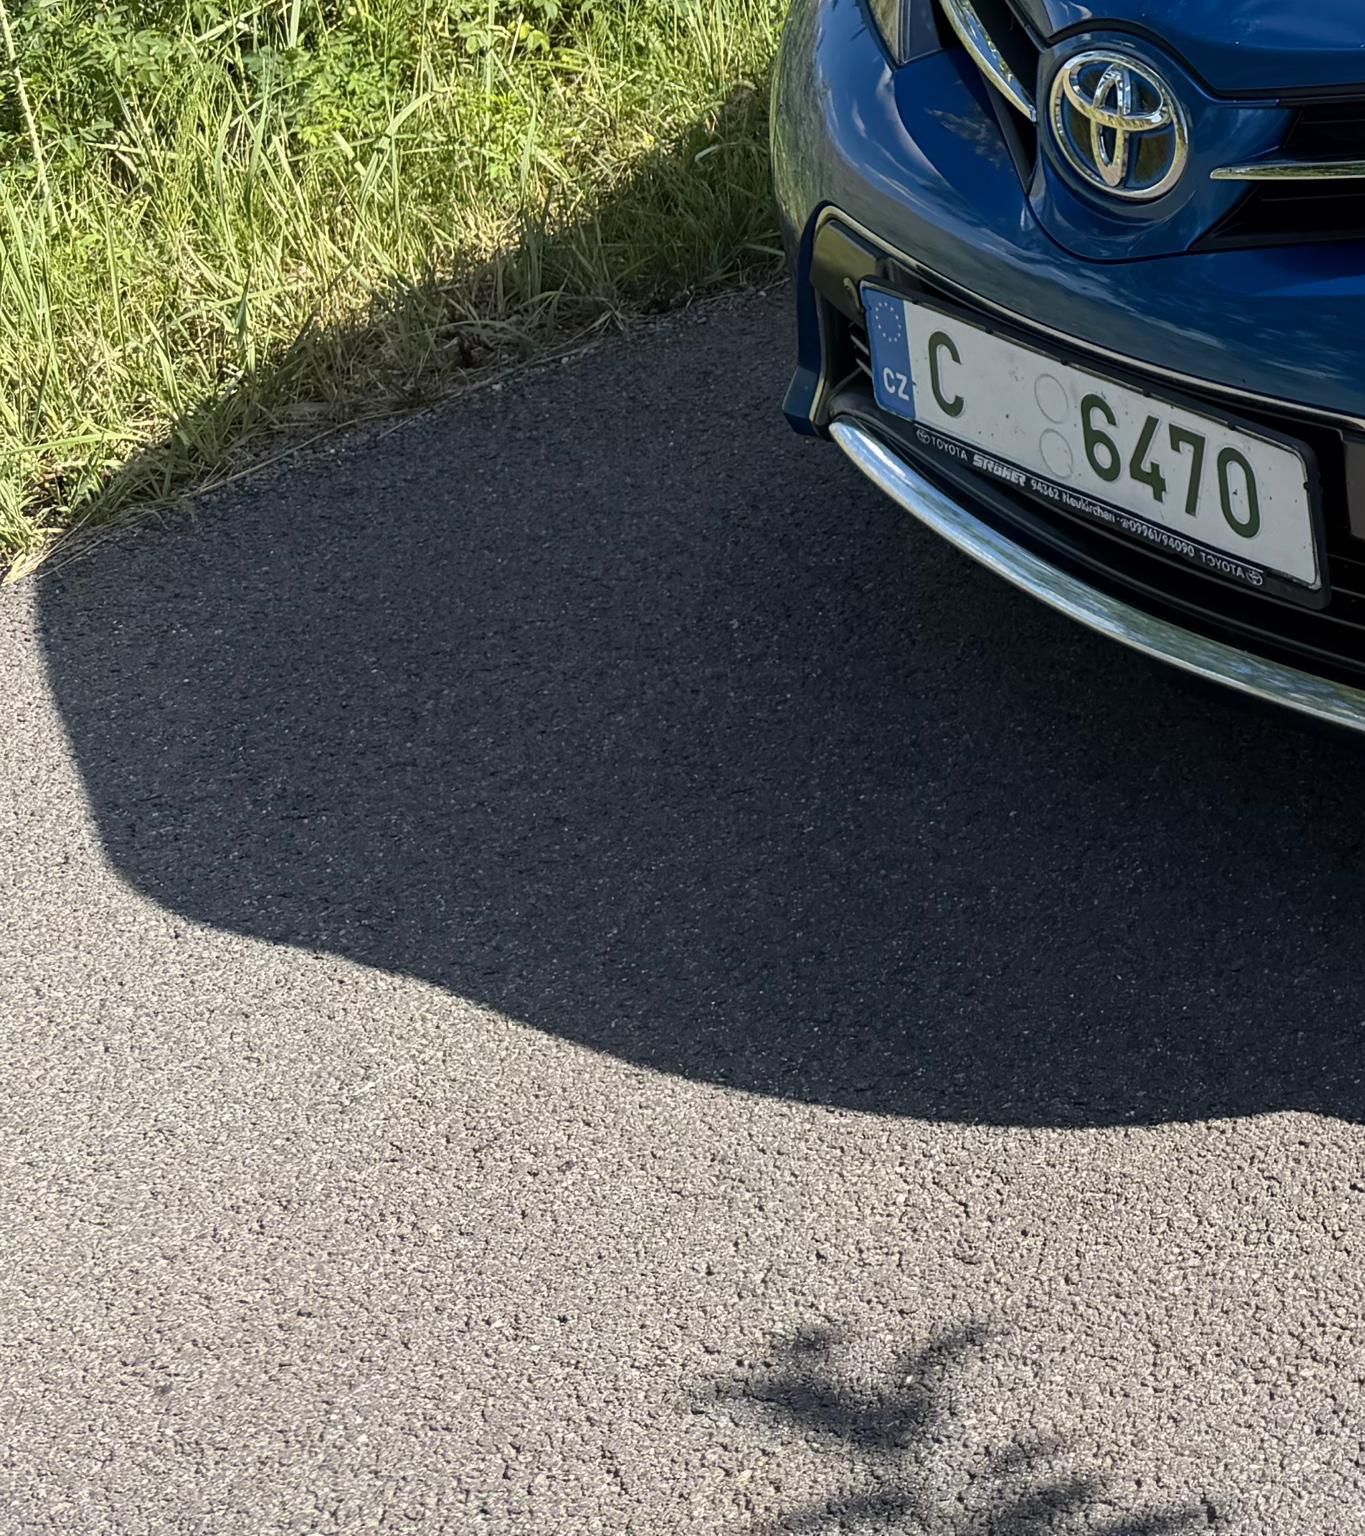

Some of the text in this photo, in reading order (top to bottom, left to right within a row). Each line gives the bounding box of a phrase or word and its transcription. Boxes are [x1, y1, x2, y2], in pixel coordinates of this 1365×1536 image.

[883, 367, 910, 401] CZ
[927, 330, 1263, 539] C 6470
[931, 436, 968, 461] TOYOTA
[1030, 479, 1061, 501] 94362
[1200, 552, 1246, 579] TOYOTA
